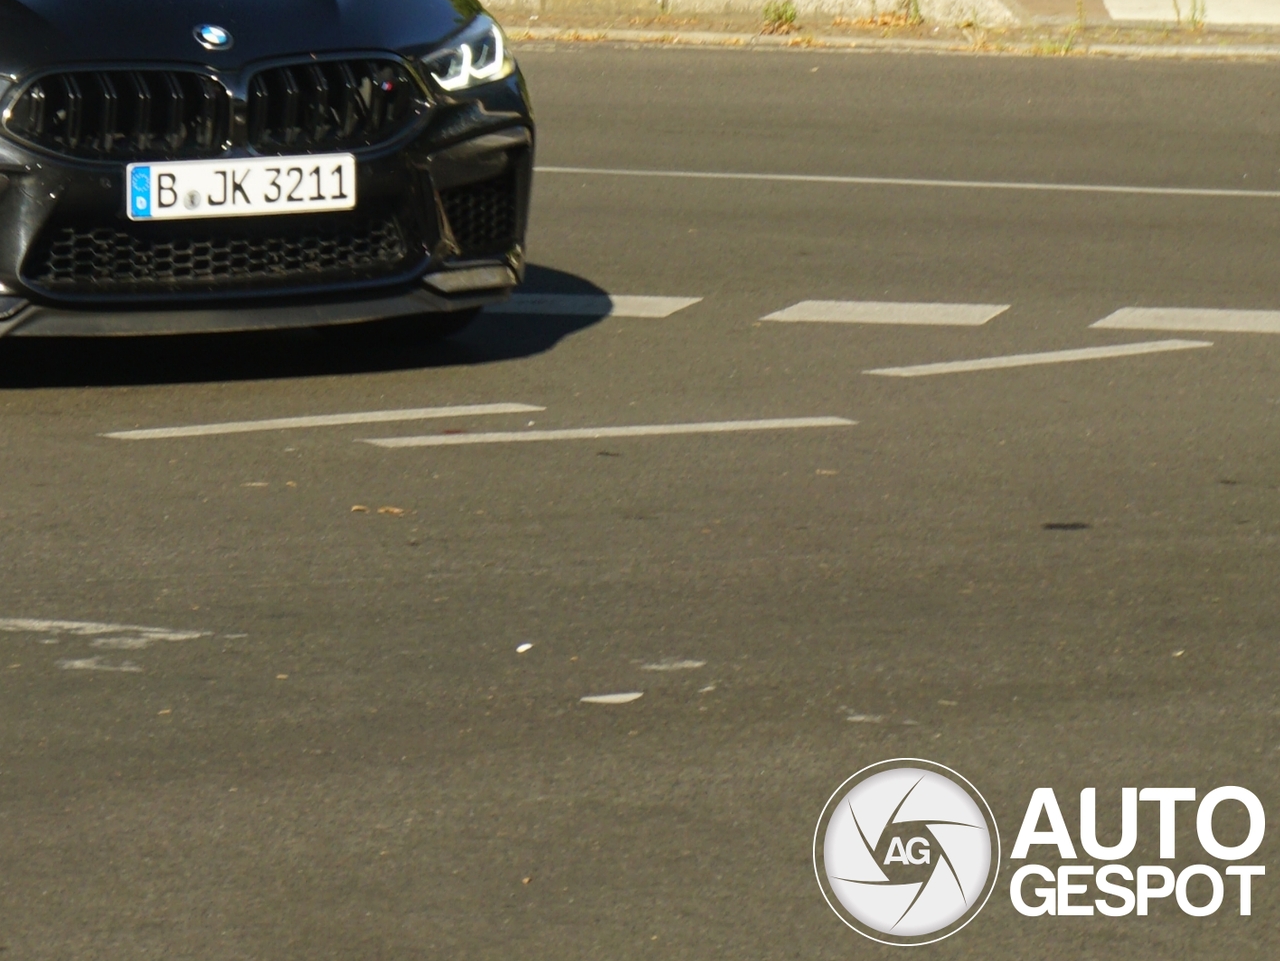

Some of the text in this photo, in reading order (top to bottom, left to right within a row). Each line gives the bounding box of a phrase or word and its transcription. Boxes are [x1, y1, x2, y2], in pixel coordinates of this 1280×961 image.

[157, 164, 348, 208] B JK 3211
